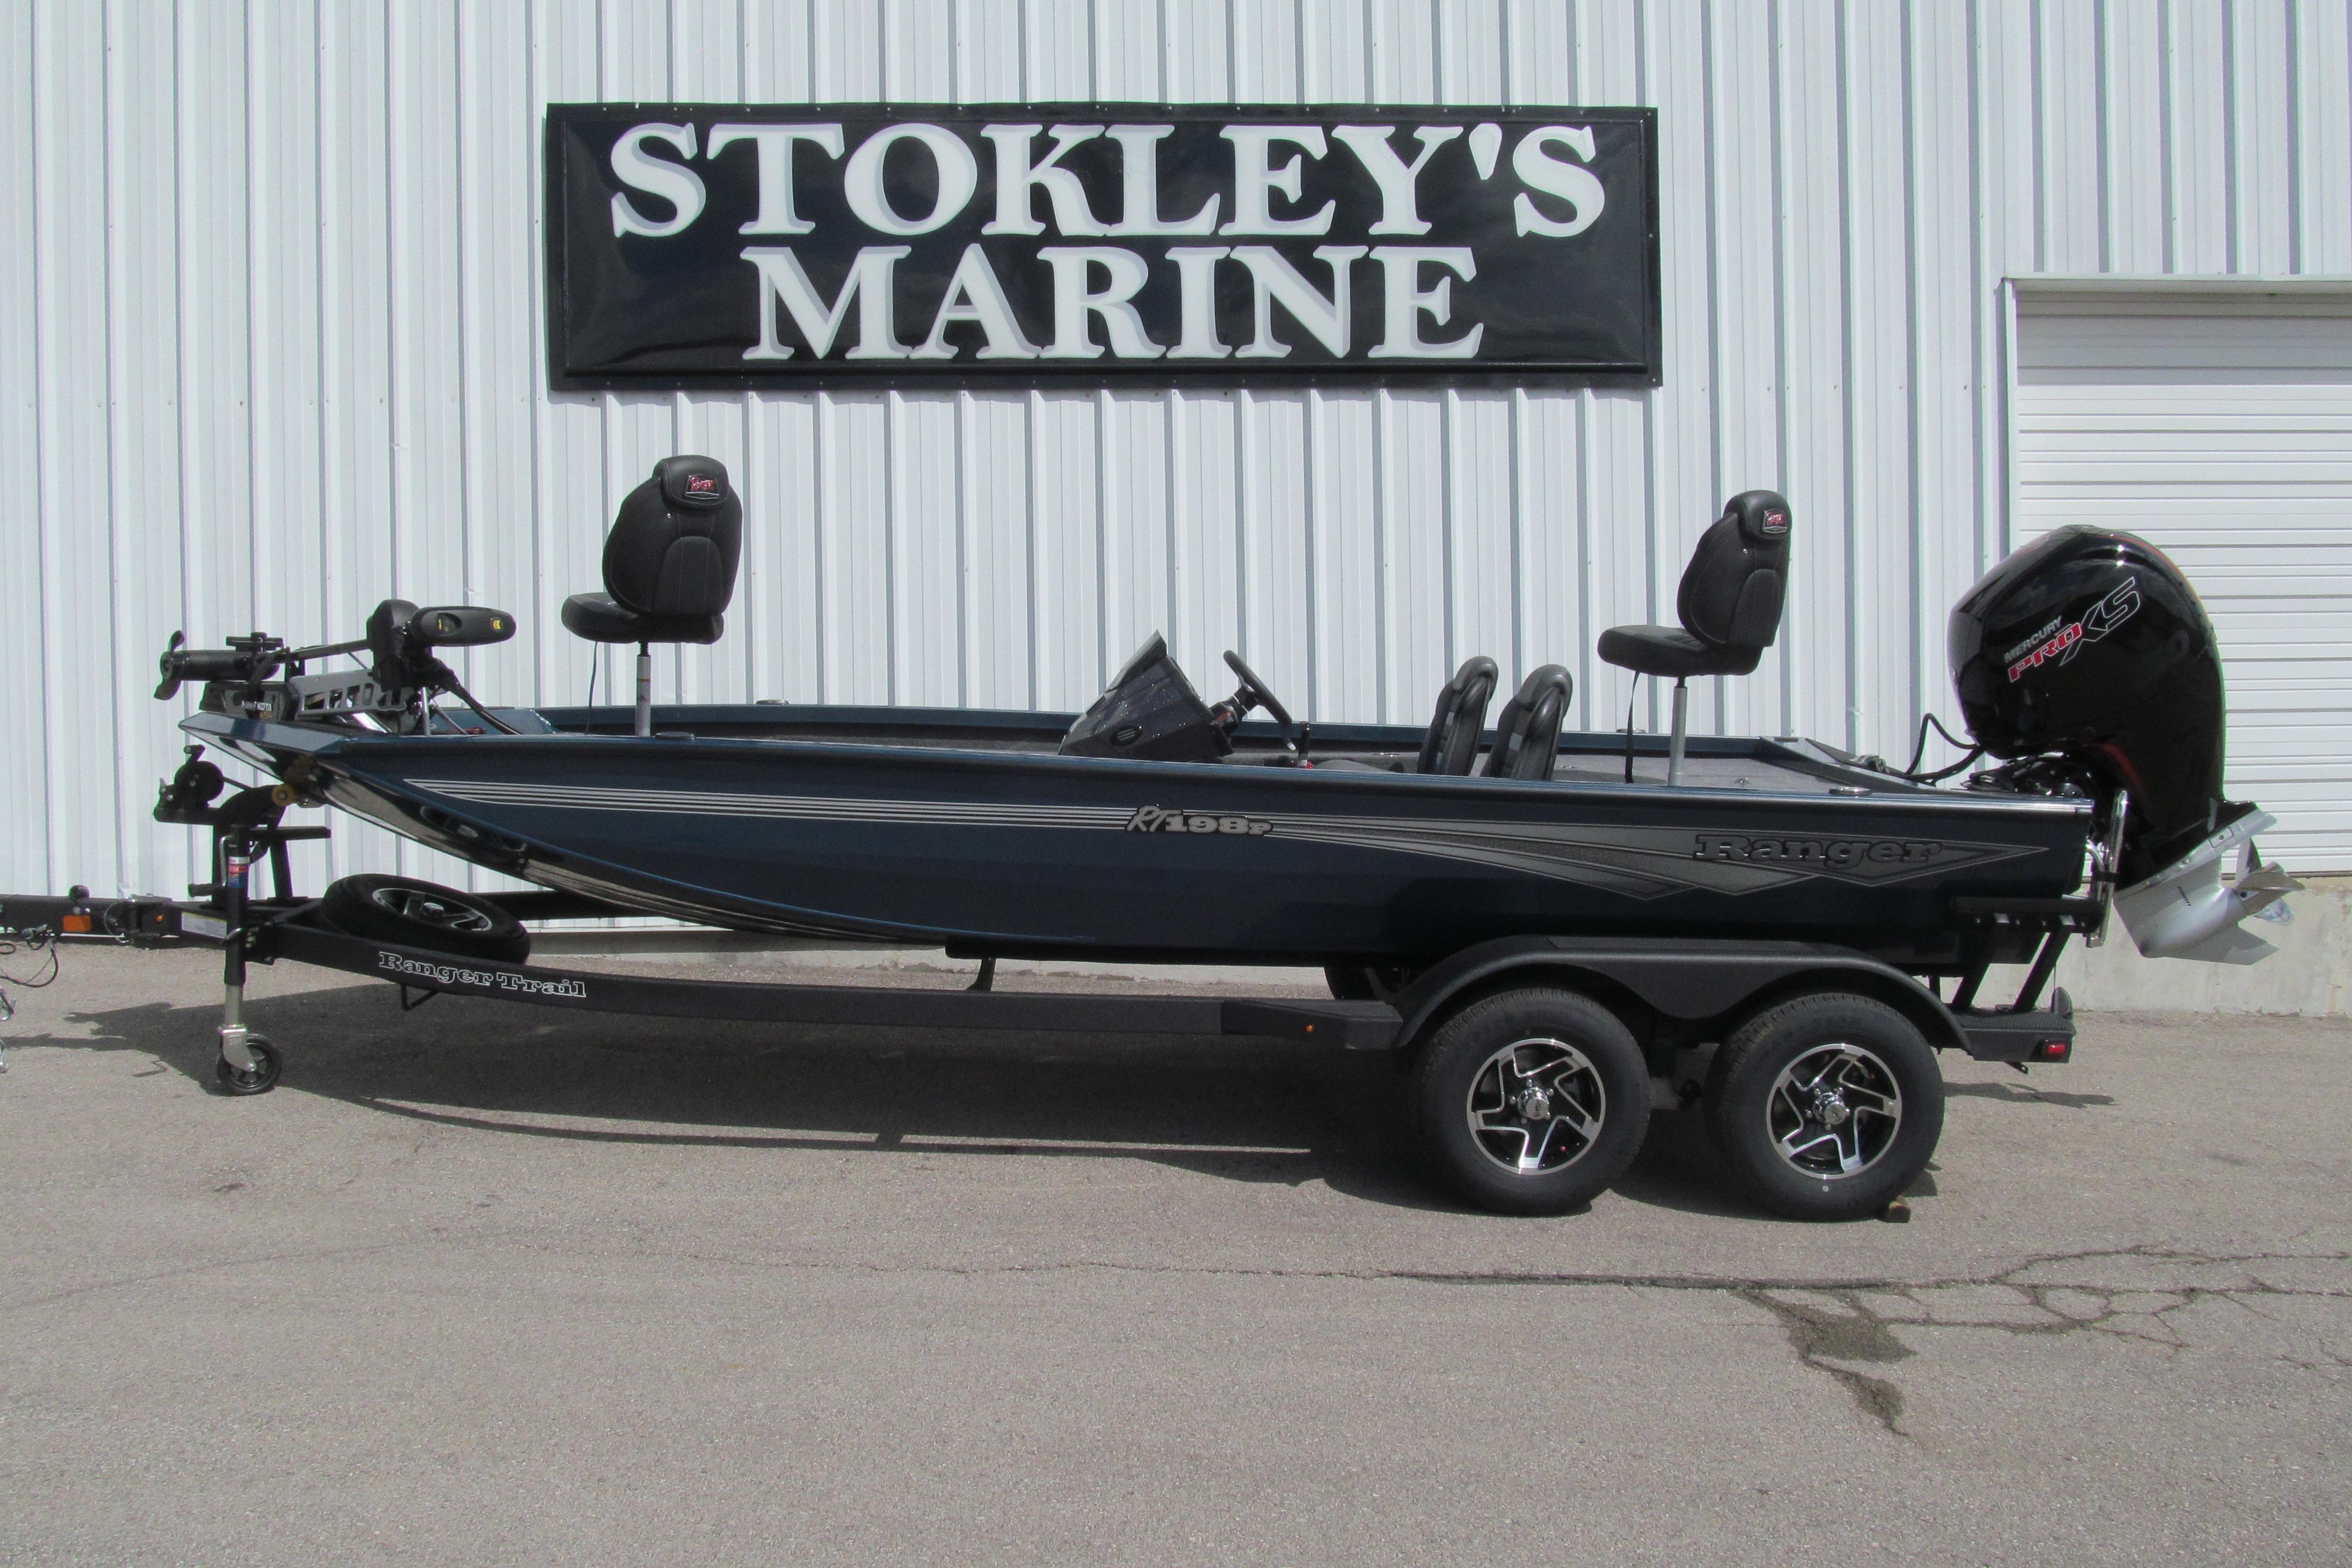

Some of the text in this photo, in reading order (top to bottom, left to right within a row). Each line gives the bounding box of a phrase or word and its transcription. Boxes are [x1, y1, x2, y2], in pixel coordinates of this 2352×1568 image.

[610, 122, 1606, 238] STOKLEY'S
[739, 243, 1485, 360] MARINE
[2003, 615, 2062, 663] MERCURY
[1693, 834, 1943, 869] Ranger
[379, 951, 586, 997] Ranger Trail
